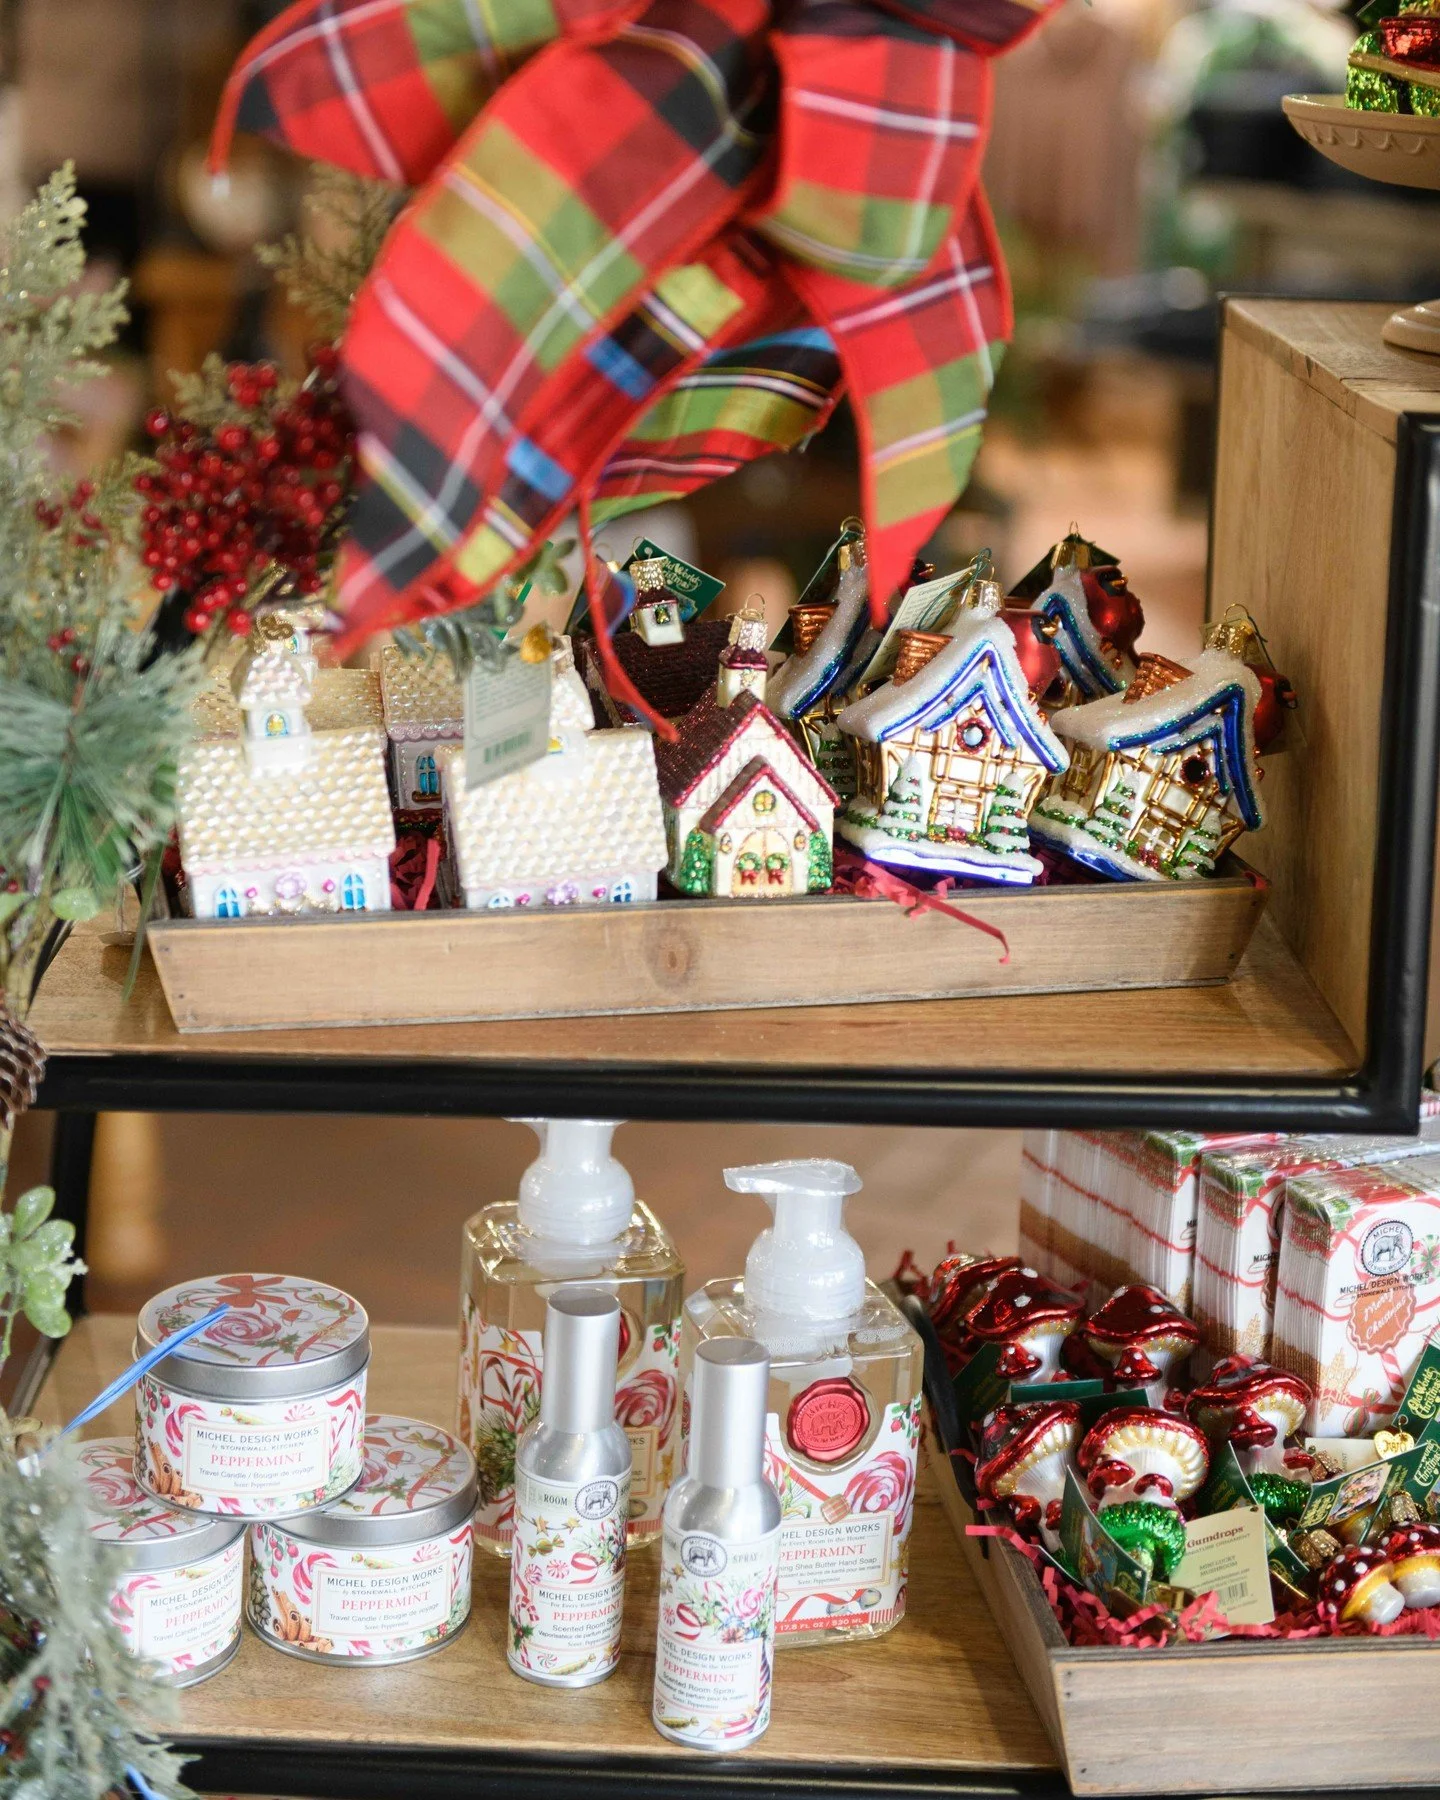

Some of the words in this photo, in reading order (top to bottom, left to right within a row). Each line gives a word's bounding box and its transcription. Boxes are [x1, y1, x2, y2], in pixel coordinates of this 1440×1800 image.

[1373, 1227, 1404, 1239] MICHEL
[1368, 1261, 1387, 1273] DESIGN
[1340, 1284, 1368, 1294] MICHEL
[1371, 1277, 1399, 1289] DESIGN
[1403, 1271, 1430, 1283] WORKS
[1357, 1288, 1391, 1299] STONEWALL
[1366, 1296, 1406, 1340] Christmas
[196, 1430, 235, 1443] MICHEL
[240, 1434, 280, 1444] DESIGN
[283, 1427, 319, 1441] WORKS
[271, 1442, 304, 1451] KITCHEN
[211, 1452, 302, 1467] PEPPERMINT
[199, 1467, 219, 1477] Travel
[221, 1471, 247, 1479] Candle
[253, 1471, 278, 1480] Bougie
[291, 1466, 315, 1477] voyage
[544, 1494, 568, 1506] ROOM
[805, 1527, 842, 1538] DESIGN
[845, 1523, 880, 1534] WORKS
[1187, 1527, 1244, 1548] Gumdrops
[1215, 1533, 1250, 1548] ORNAMENT
[733, 1553, 757, 1562] SPRAY
[779, 1544, 866, 1561] PEPPERMINT
[795, 1563, 813, 1571] Shea
[815, 1560, 836, 1568] Butter
[860, 1557, 878, 1565] Soap
[1200, 1561, 1238, 1576] MUSHROOM
[327, 1577, 366, 1588] MICHEL
[371, 1576, 409, 1588] DESIGN
[412, 1564, 443, 1582] WORKS
[150, 1593, 188, 1607] MICHEL
[192, 1579, 222, 1598] DESIGN
[400, 1581, 431, 1592] KITCHEN
[341, 1591, 430, 1610] PEPPERMINT
[539, 1590, 573, 1602] MICHEL
[577, 1588, 609, 1601] DESIGN
[165, 1590, 234, 1629] PEPPERMINT
[330, 1613, 350, 1621] Travel
[383, 1613, 408, 1621] Bougie
[408, 1609, 417, 1617] de
[419, 1602, 440, 1614] voyage
[553, 1600, 621, 1621] PEPPERMINT
[381, 1621, 409, 1631] Peppermint
[553, 1624, 584, 1632] Scented
[586, 1621, 606, 1631] Room
[780, 1622, 798, 1631] 17.8
[813, 1620, 824, 1628] OZ
[831, 1618, 849, 1626] 530
[153, 1633, 173, 1642] Travel
[175, 1627, 197, 1638] Candle
[539, 1630, 573, 1639] Vaporisateur
[583, 1630, 602, 1639] parfum
[585, 1634, 611, 1646] Peppermint
[681, 1647, 715, 1662] DESIGN
[720, 1651, 752, 1662] WORKS
[664, 1658, 735, 1683] PEPPERMINT
[685, 1691, 706, 1700] parfum
[688, 1683, 711, 1694] Room
[713, 1687, 736, 1696] Spray
[687, 1700, 719, 1710] Peppermint
